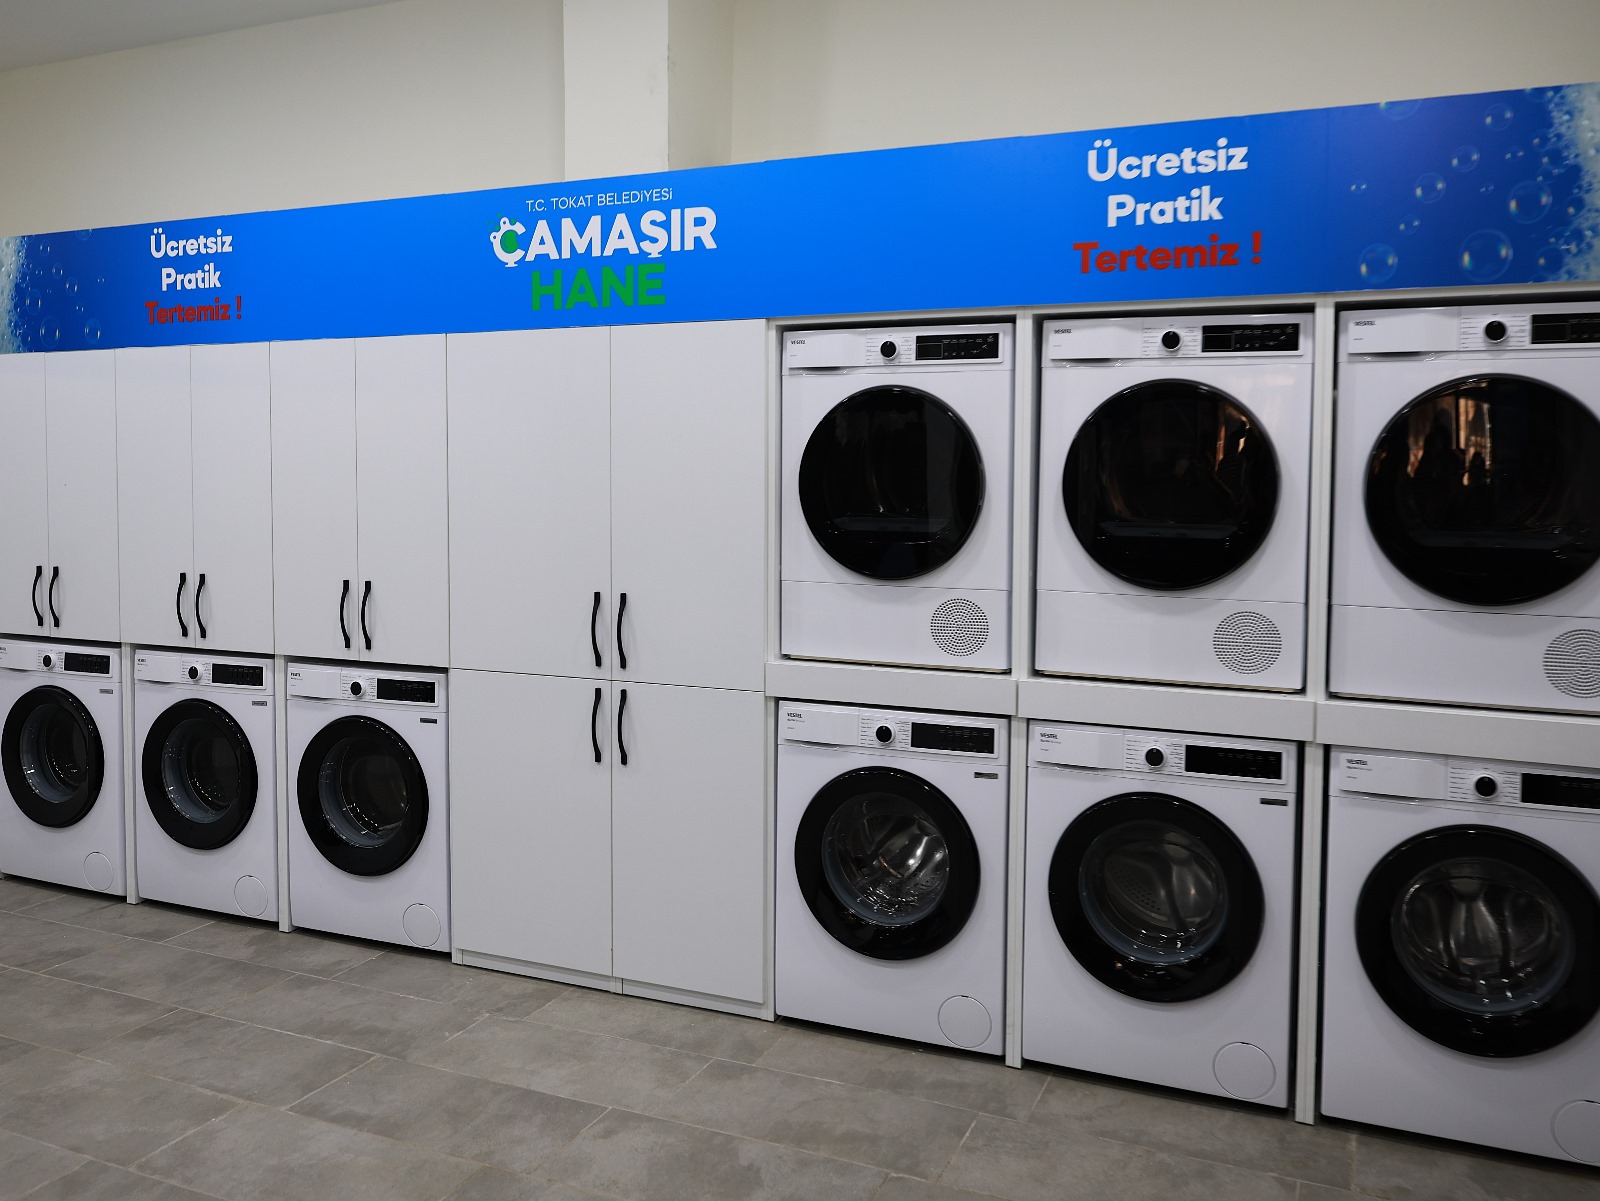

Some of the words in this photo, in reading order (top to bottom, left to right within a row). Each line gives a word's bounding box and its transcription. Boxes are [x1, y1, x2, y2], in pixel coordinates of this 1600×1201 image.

[1087, 137, 1248, 182] Ücretsiz
[526, 199, 548, 213] T.C.
[550, 194, 594, 210] TOKAT
[1107, 185, 1224, 228] Pratik
[150, 228, 233, 259] Ücretsiz
[490, 206, 718, 267] ÇAMAŞIR
[1072, 234, 1240, 274] Tertemiz
[1251, 231, 1262, 265] !
[161, 262, 222, 292] Pratik
[531, 262, 667, 311] HANE
[144, 297, 230, 325] Tertemiz
[235, 295, 242, 320] !
